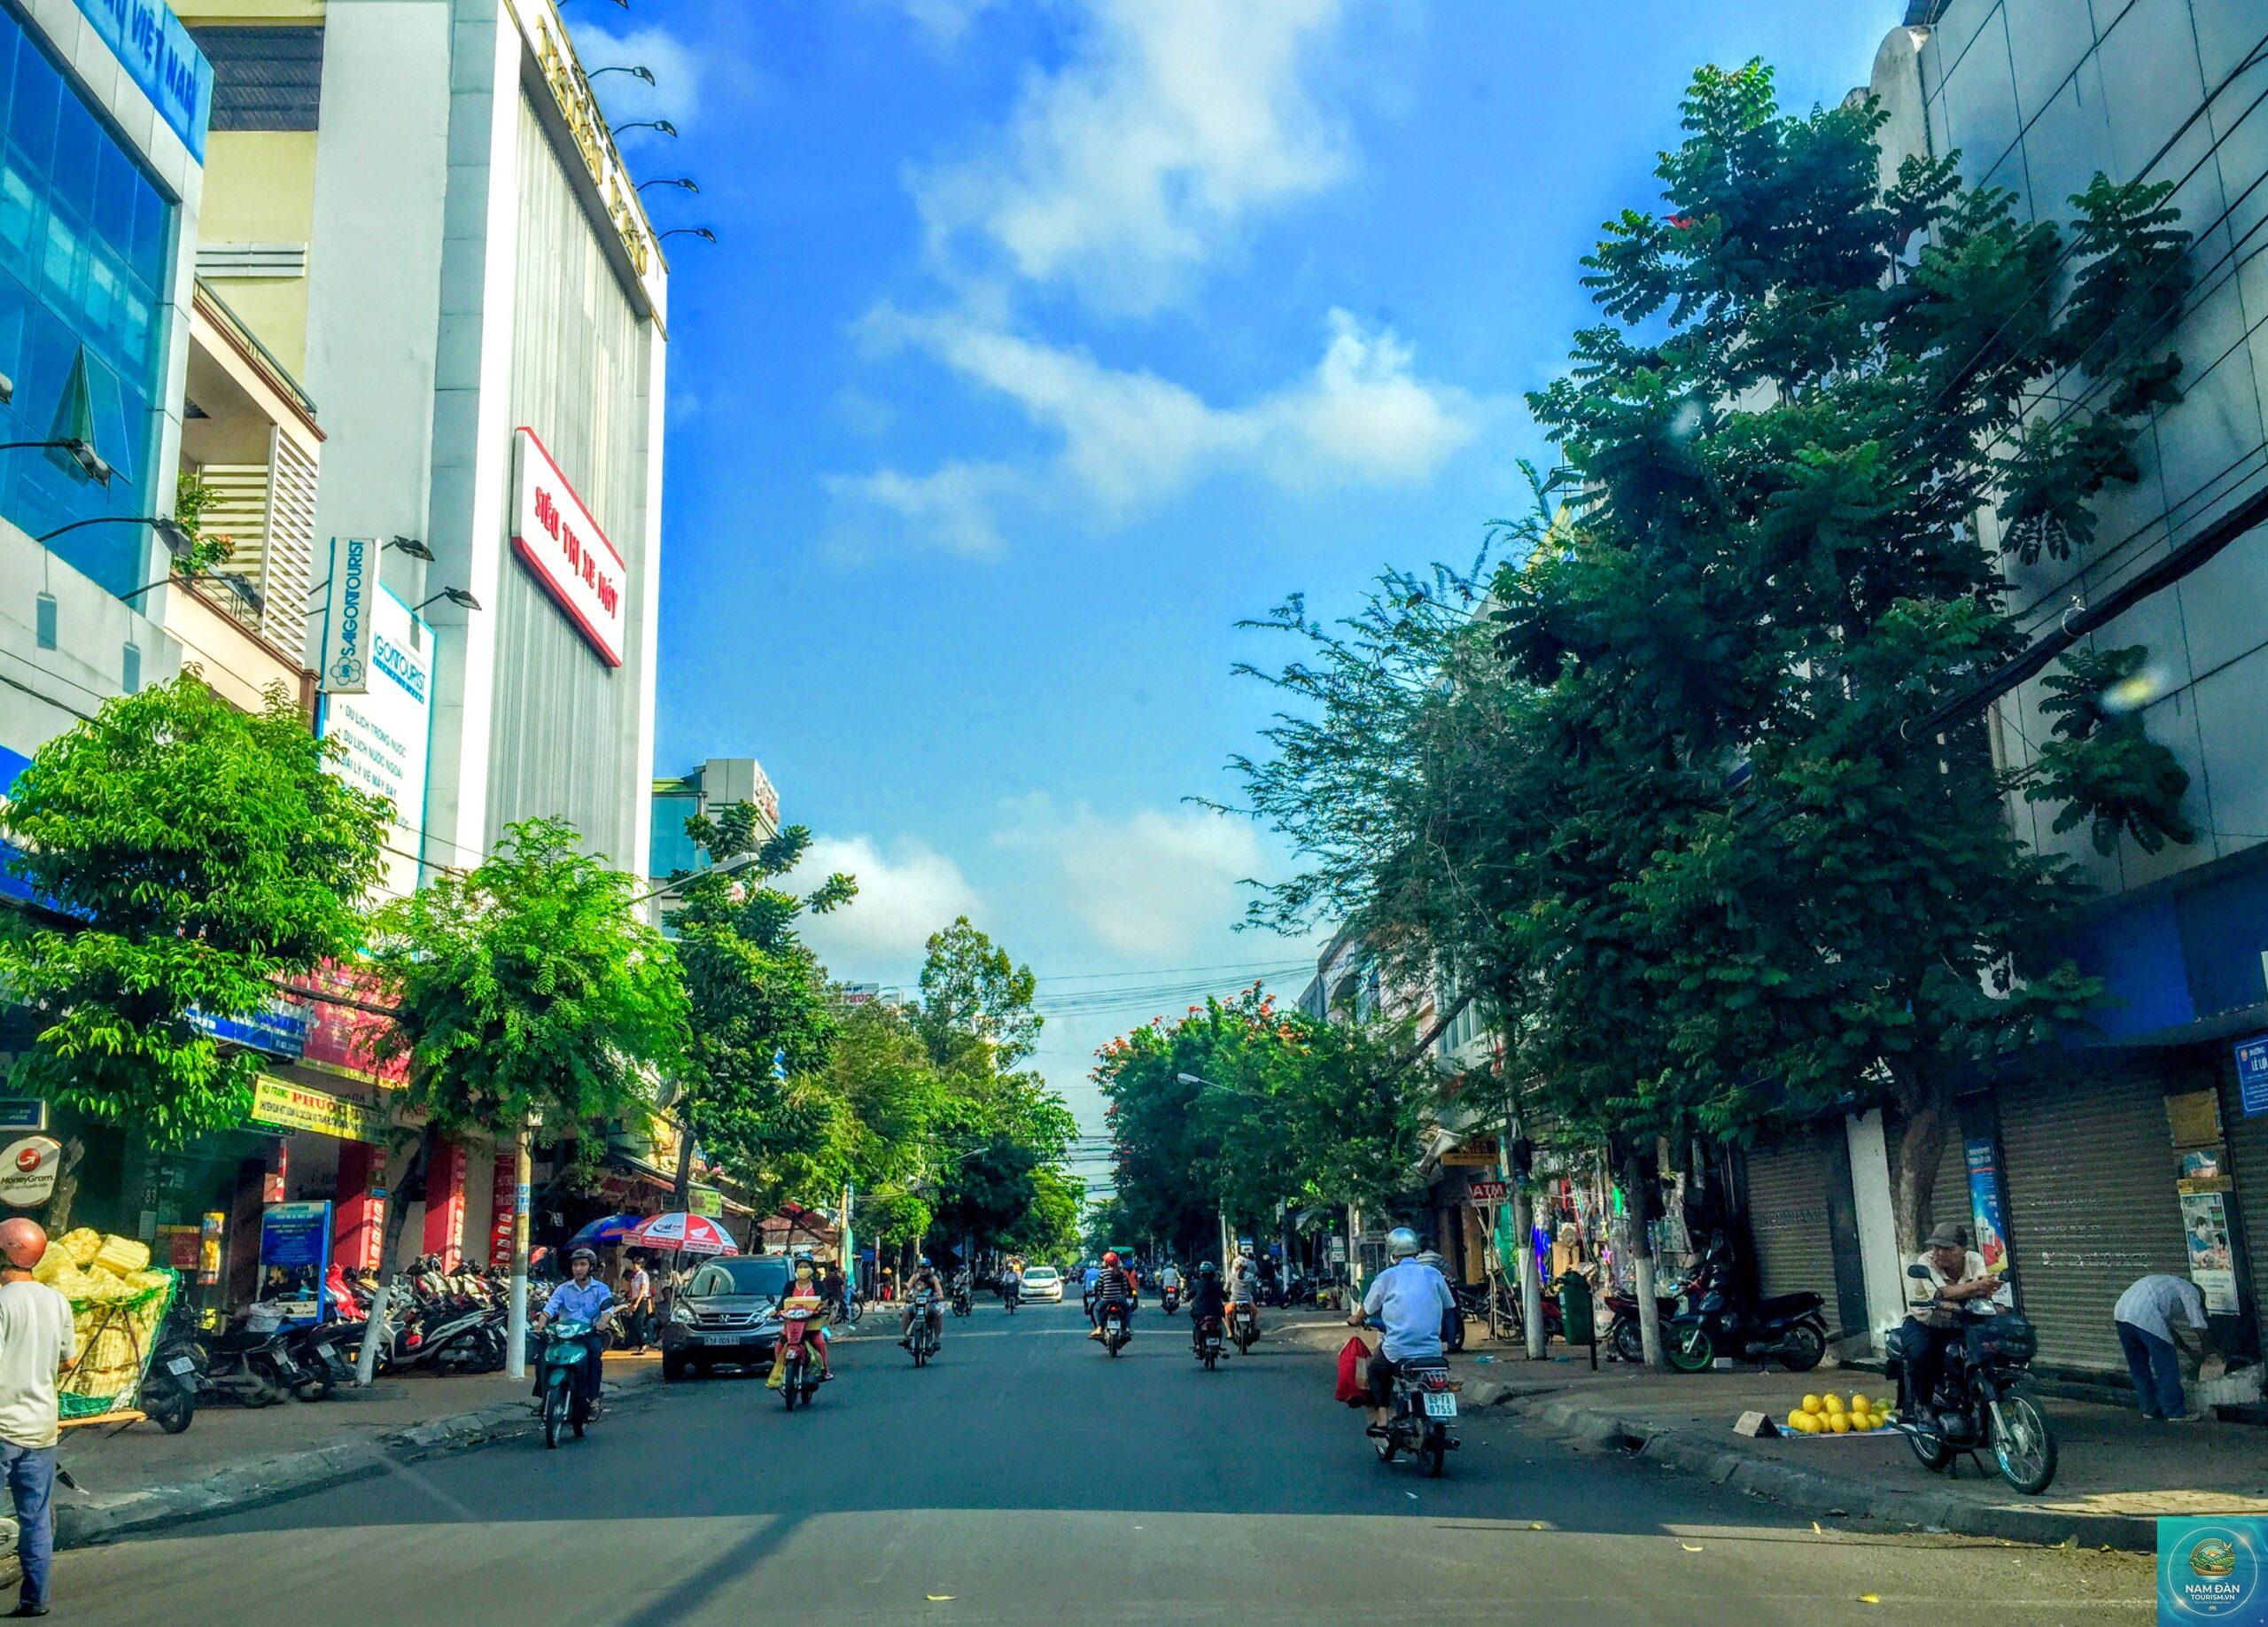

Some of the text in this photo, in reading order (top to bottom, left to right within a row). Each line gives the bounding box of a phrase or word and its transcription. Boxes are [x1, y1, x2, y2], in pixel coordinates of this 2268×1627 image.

[582, 549, 595, 589] XE
[341, 540, 364, 657] SAIGONTOURIST
[1473, 1184, 1503, 1196] ATM
[1429, 1405, 1452, 1414] 0755
